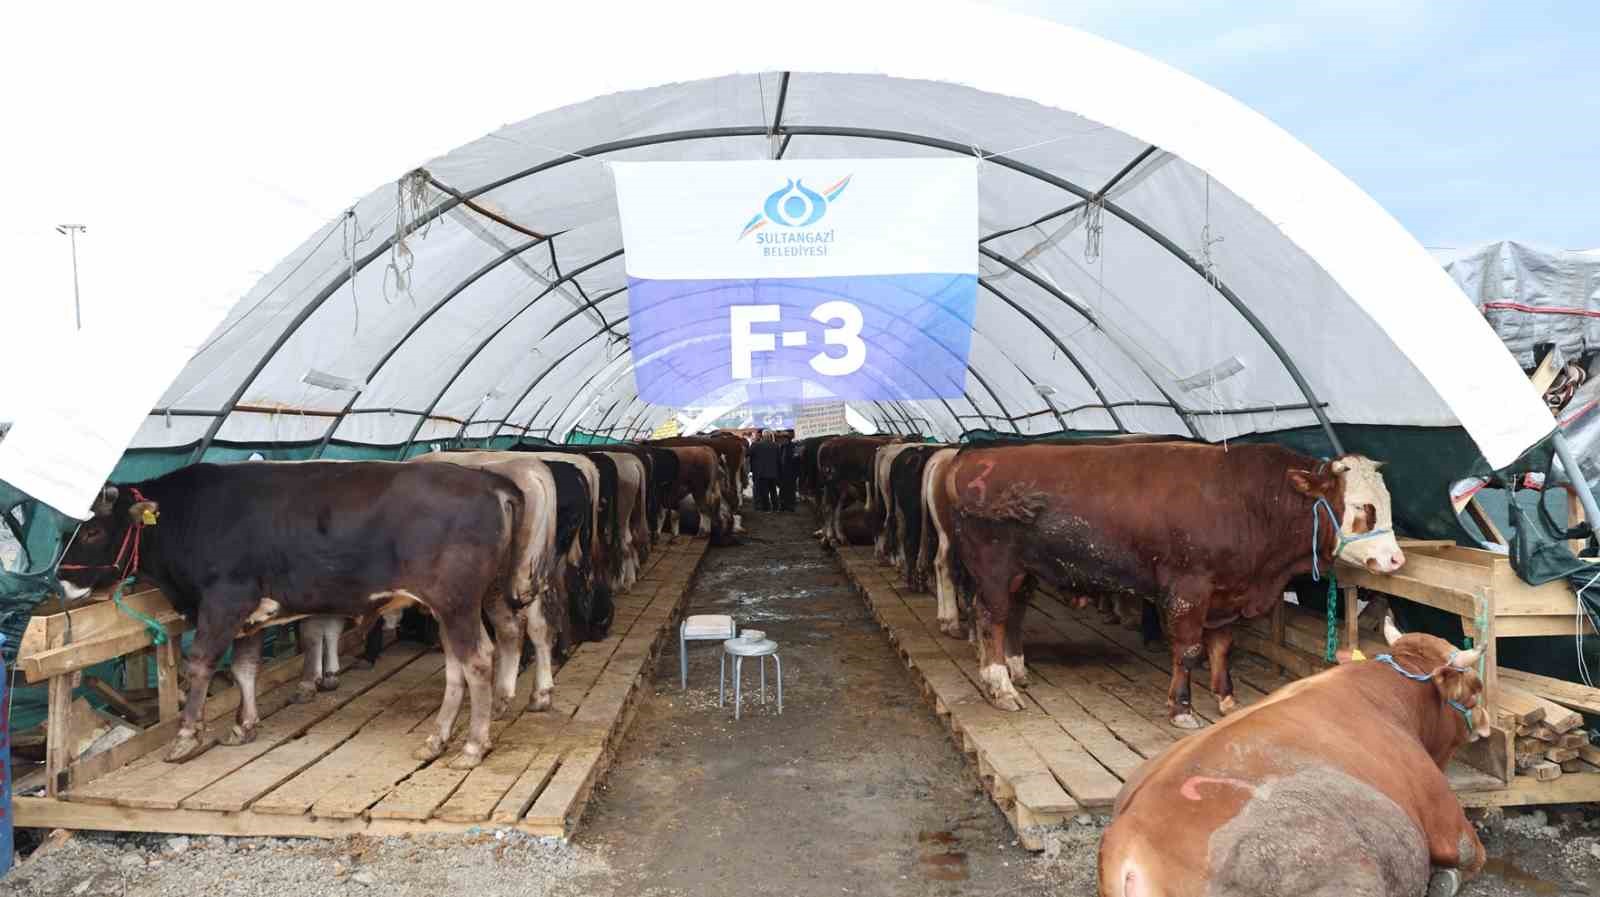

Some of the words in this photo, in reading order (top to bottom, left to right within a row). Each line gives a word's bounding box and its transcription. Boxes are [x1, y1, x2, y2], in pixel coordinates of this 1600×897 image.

[756, 229, 834, 244] SULTANGAZİ
[763, 245, 827, 256] BELEDİYESİ
[730, 300, 866, 379] F-3
